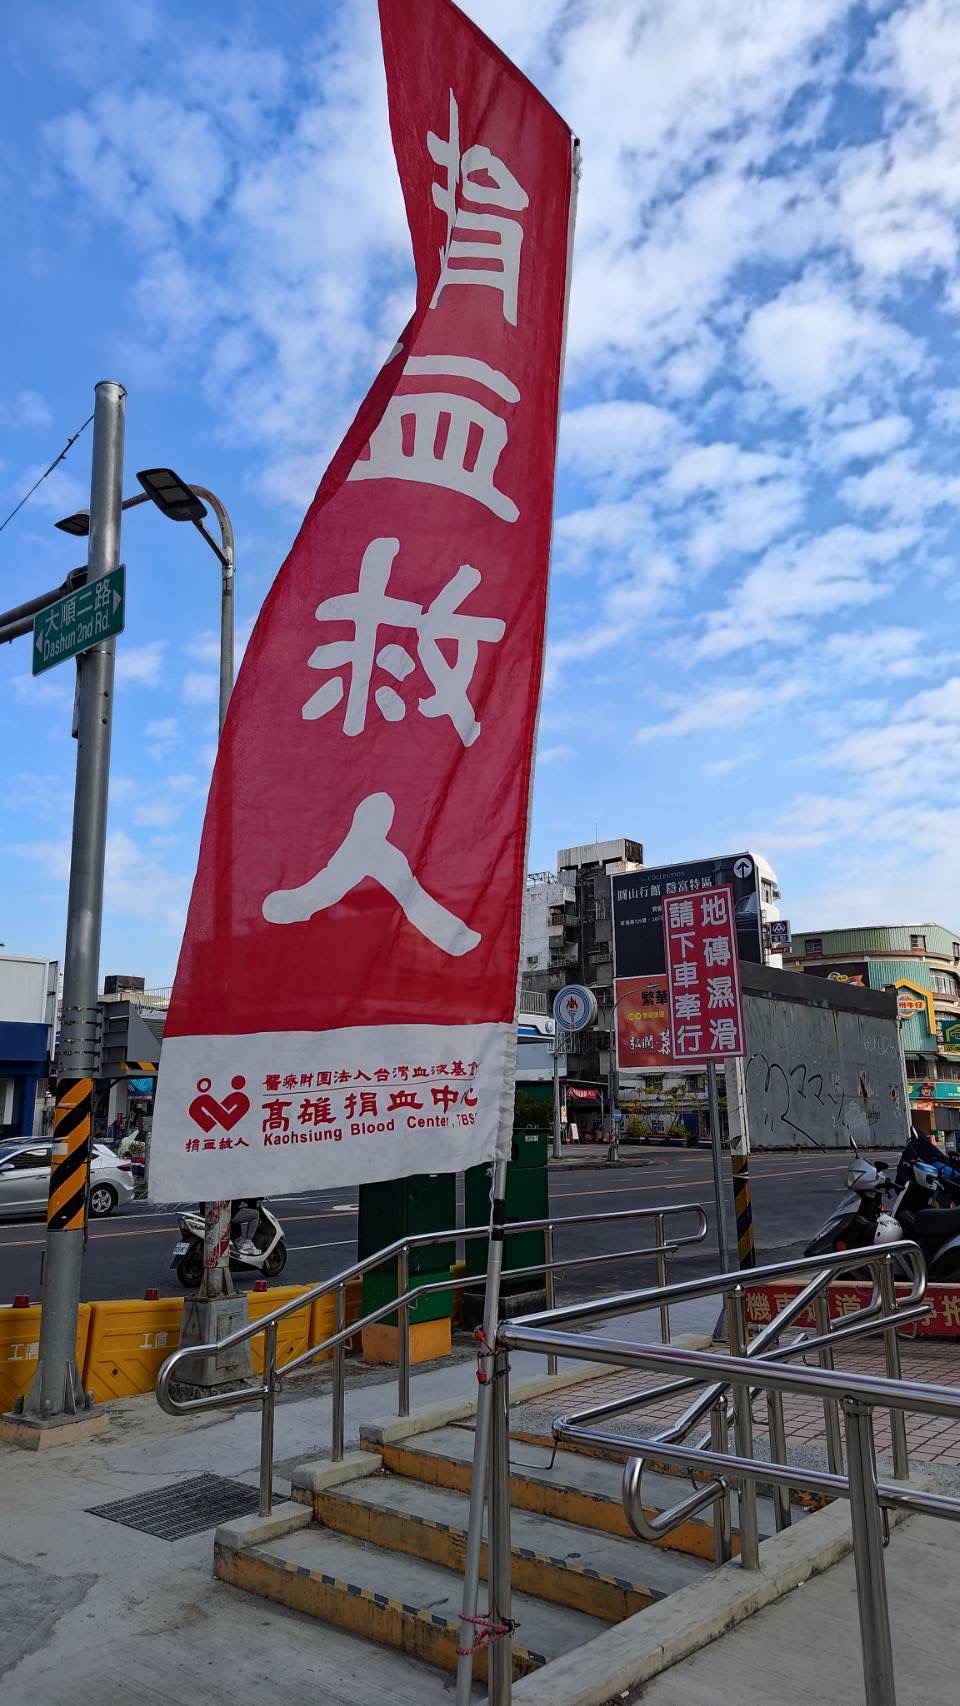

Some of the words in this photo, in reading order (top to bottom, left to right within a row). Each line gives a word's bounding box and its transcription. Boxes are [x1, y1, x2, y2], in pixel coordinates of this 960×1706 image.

[262, 88, 529, 956] 捐血救人
[43, 630, 76, 661] Dashun
[77, 619, 93, 643] 2nd
[94, 608, 111, 634] Rd.
[44, 578, 112, 638] 大順二路
[669, 900, 703, 1053] 請下車牽行
[700, 895, 737, 1050] 地磚濕滑
[262, 1085, 478, 1132] 高雄捐血中心
[263, 1128, 343, 1146] Kaohsiung
[351, 1118, 395, 1136] Blood
[457, 1113, 478, 1126] TBS
